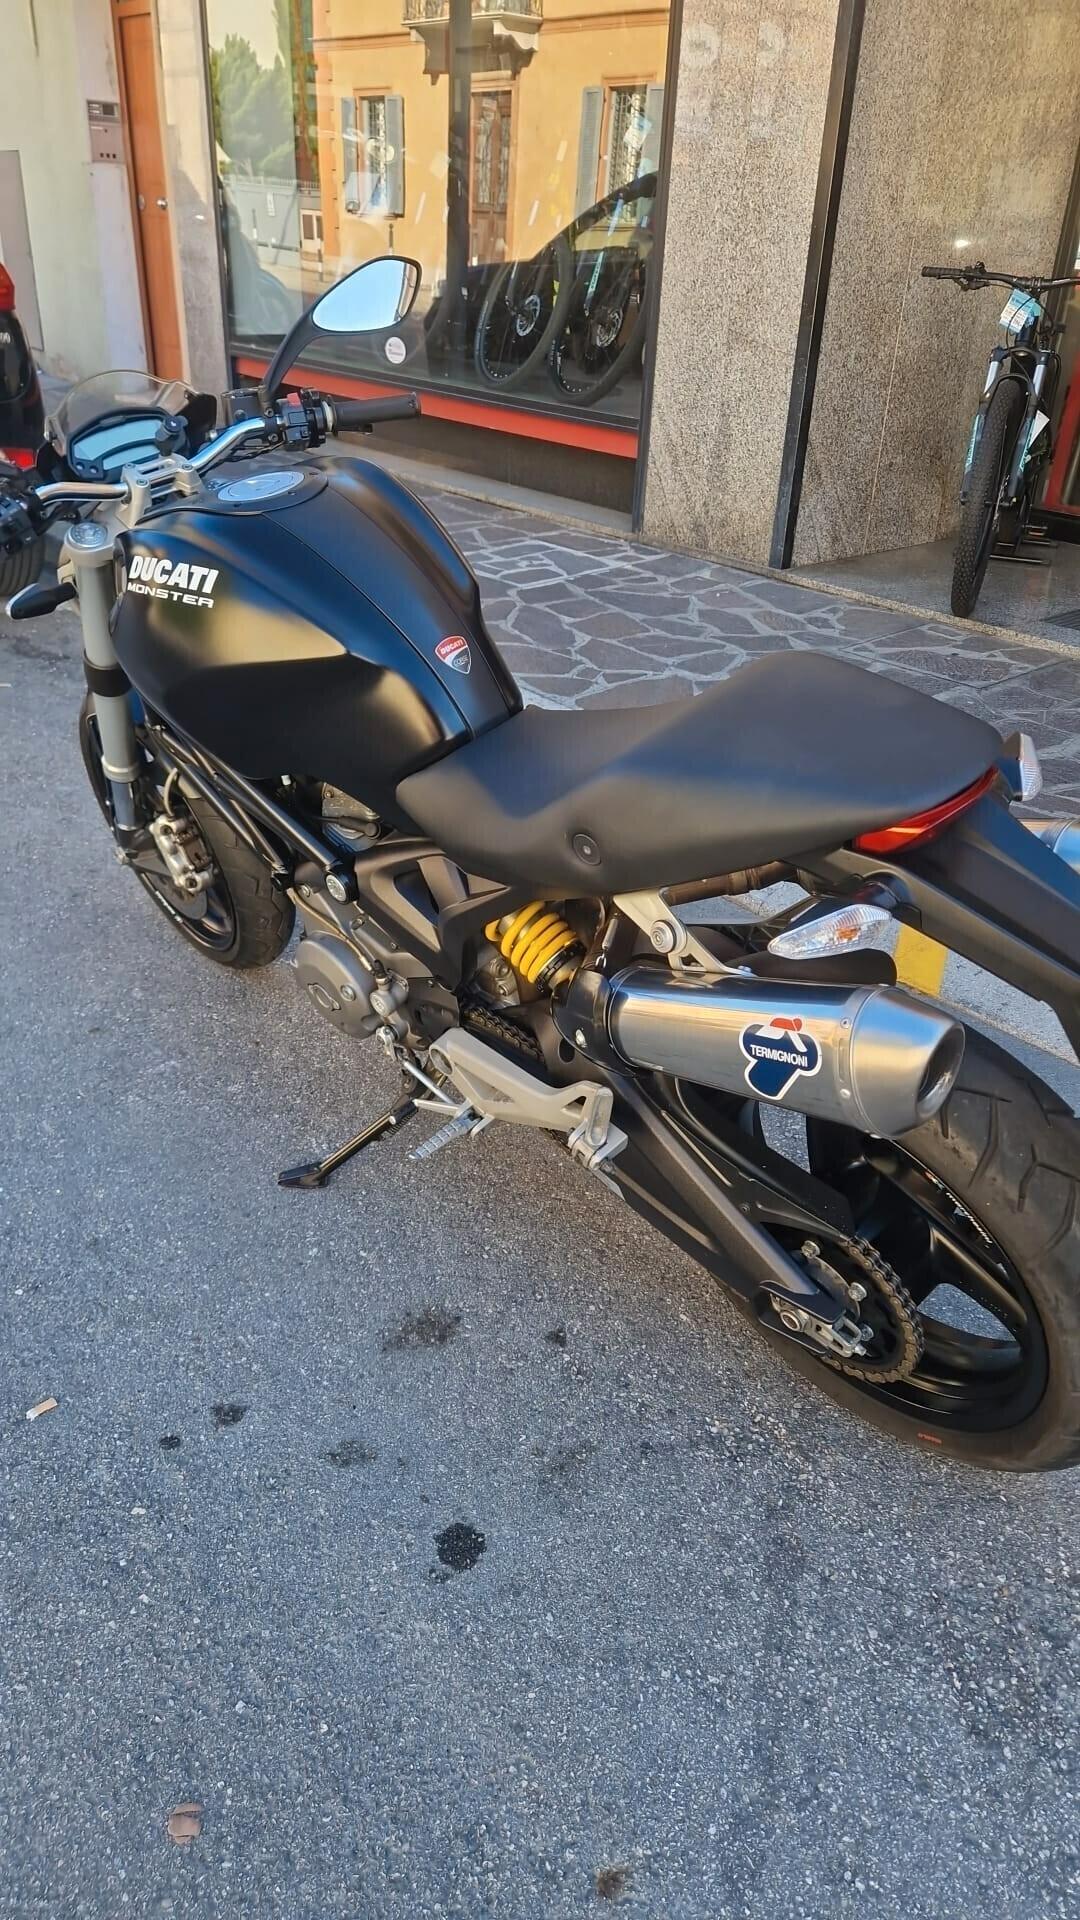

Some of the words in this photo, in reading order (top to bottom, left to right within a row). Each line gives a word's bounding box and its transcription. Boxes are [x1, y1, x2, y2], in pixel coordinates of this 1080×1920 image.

[128, 555, 219, 593] DUCATI
[127, 582, 214, 608] MONSTER
[440, 639, 464, 655] DUCATI
[750, 1044, 808, 1067] TERMIGNONI
